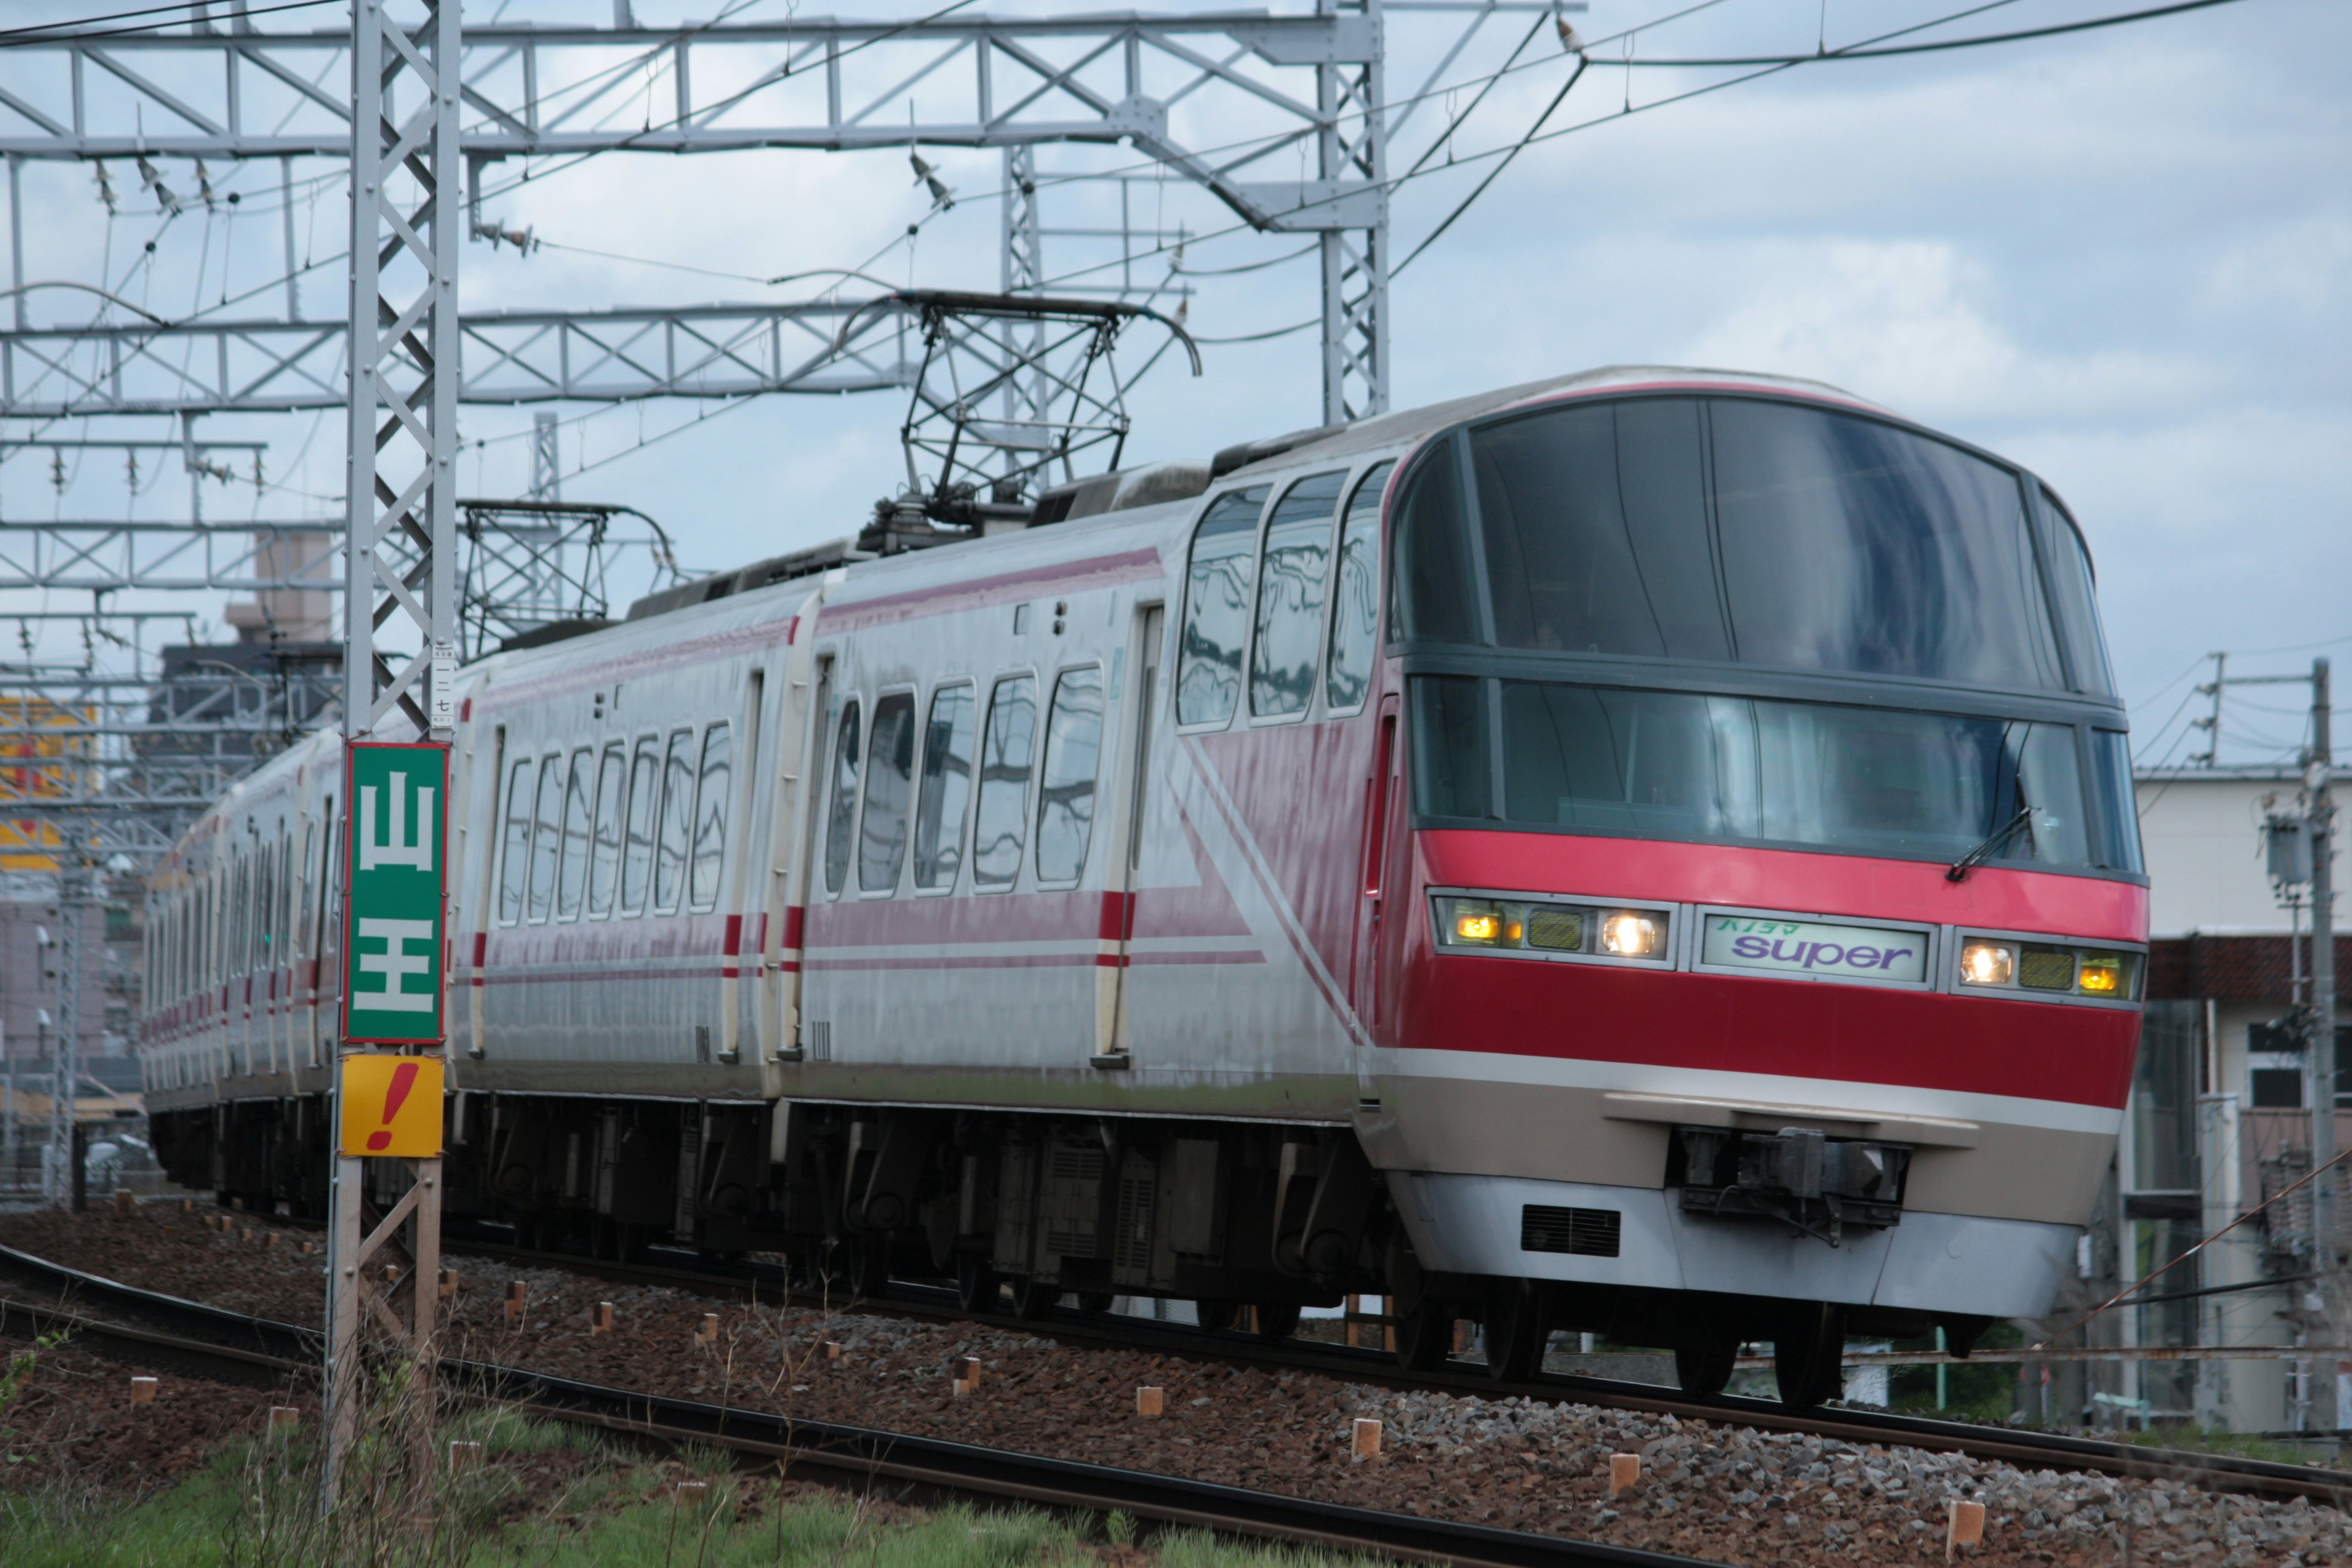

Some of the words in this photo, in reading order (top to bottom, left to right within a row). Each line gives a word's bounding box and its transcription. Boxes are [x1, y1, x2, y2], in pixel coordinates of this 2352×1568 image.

[353, 771, 434, 1012] 山王
[1717, 919, 1800, 935] パノラマ
[1732, 936, 1913, 970] super
